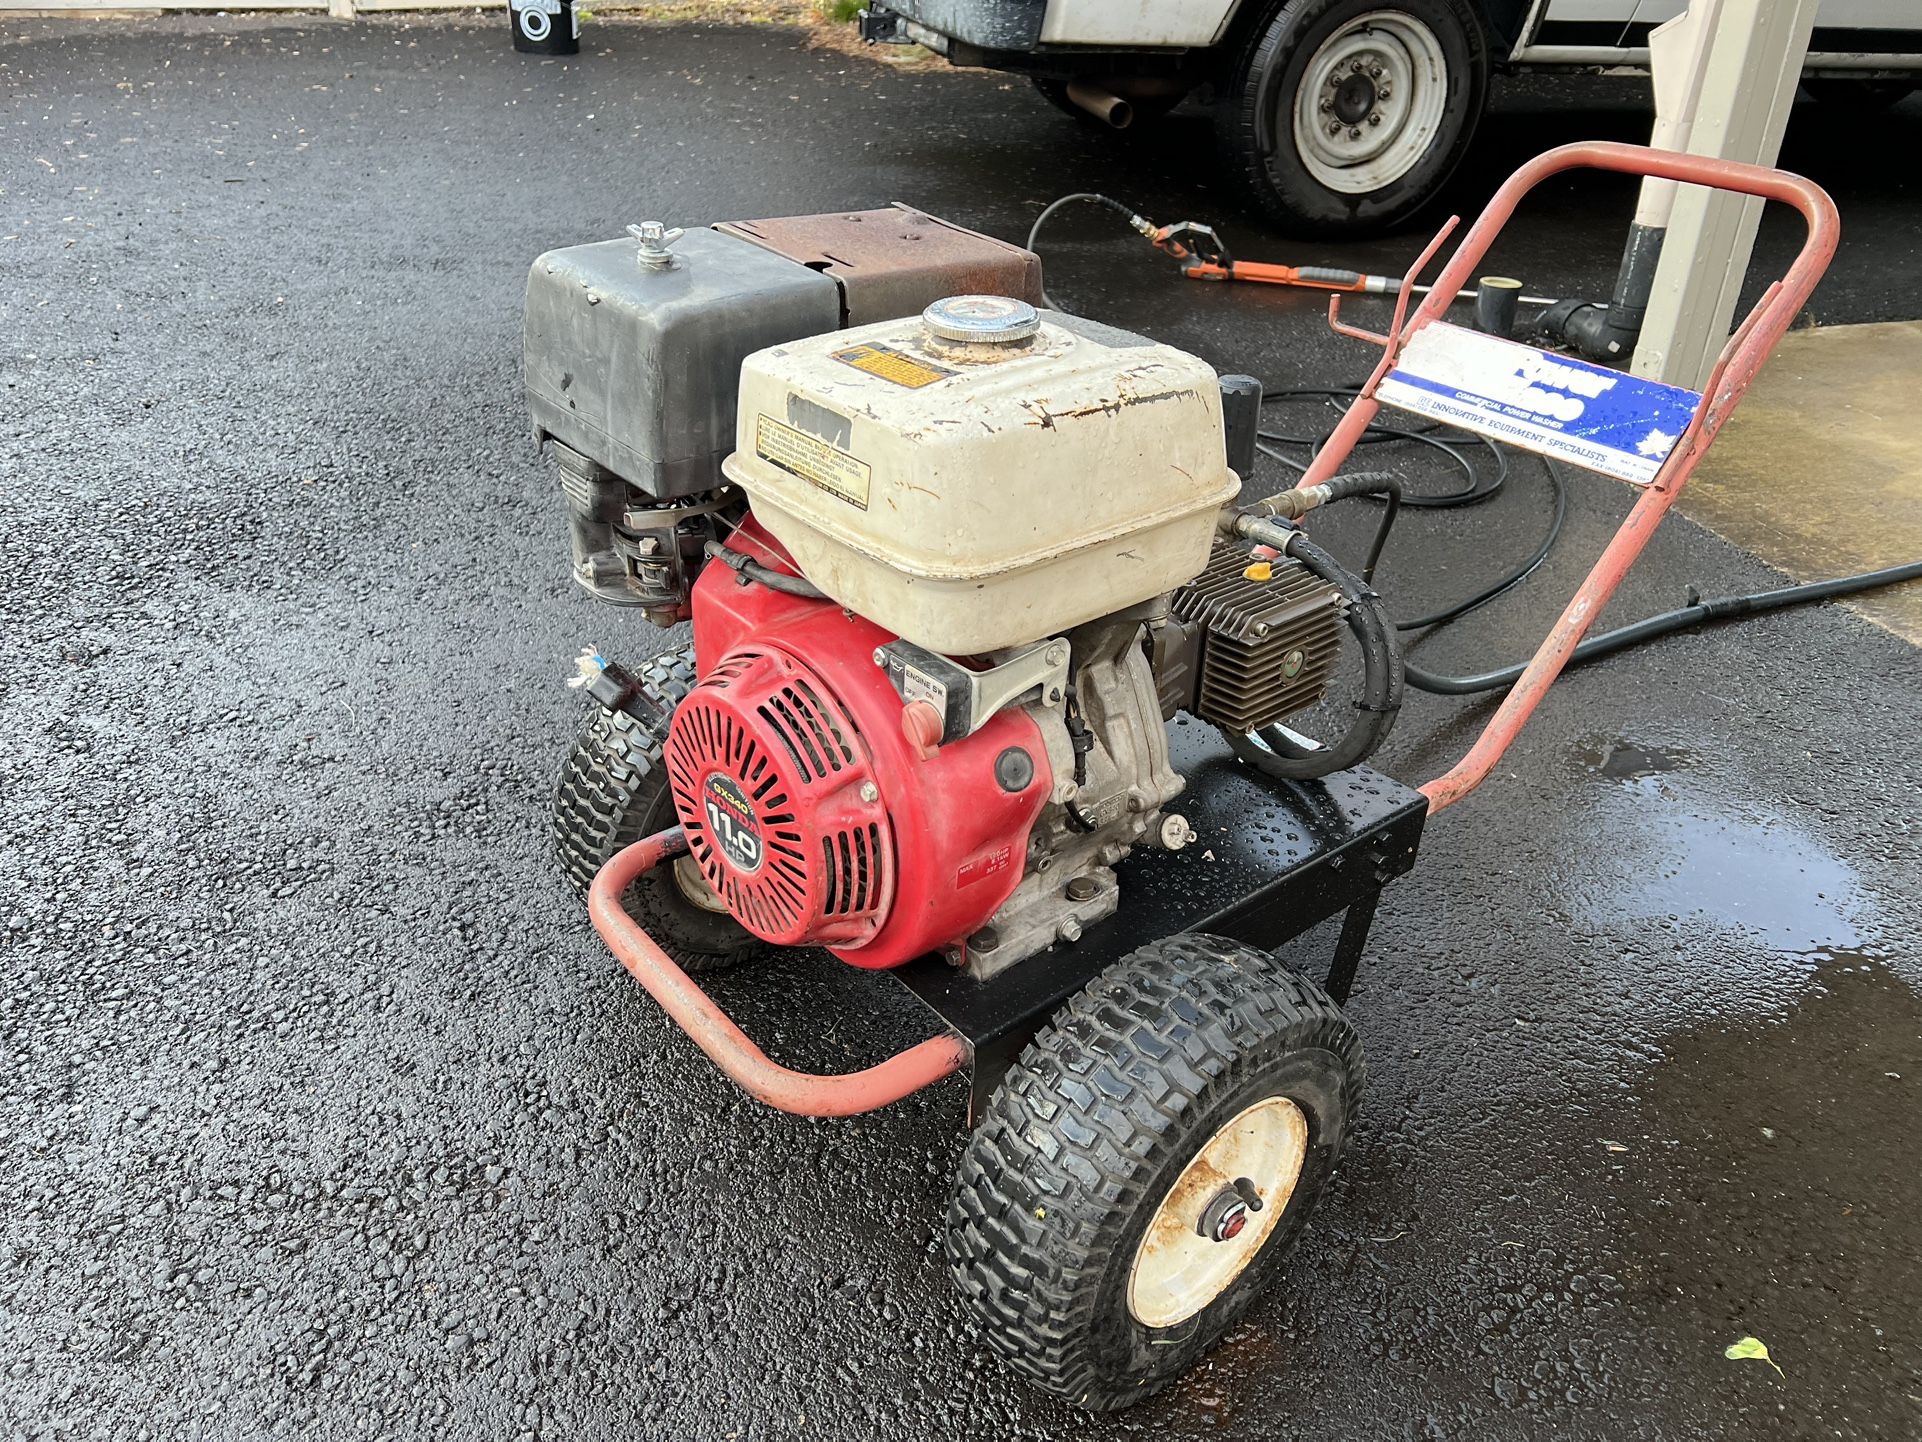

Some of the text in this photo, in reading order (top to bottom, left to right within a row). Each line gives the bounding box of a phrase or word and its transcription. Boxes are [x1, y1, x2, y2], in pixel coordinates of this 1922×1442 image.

[1502, 405, 1532, 419] POWER
[1531, 413, 1564, 429] WASHER
[795, 434, 813, 448] MANUAL
[1431, 401, 1487, 424] INNOVATIVE
[1488, 418, 1546, 443] EQUIPMENT
[1547, 438, 1608, 462] SPECIALISTS
[906, 670, 931, 690] ENGINE
[925, 691, 935, 700] ON
[706, 788, 761, 838] HONDA
[707, 803, 757, 859] 11.0
[725, 840, 746, 863] HP
